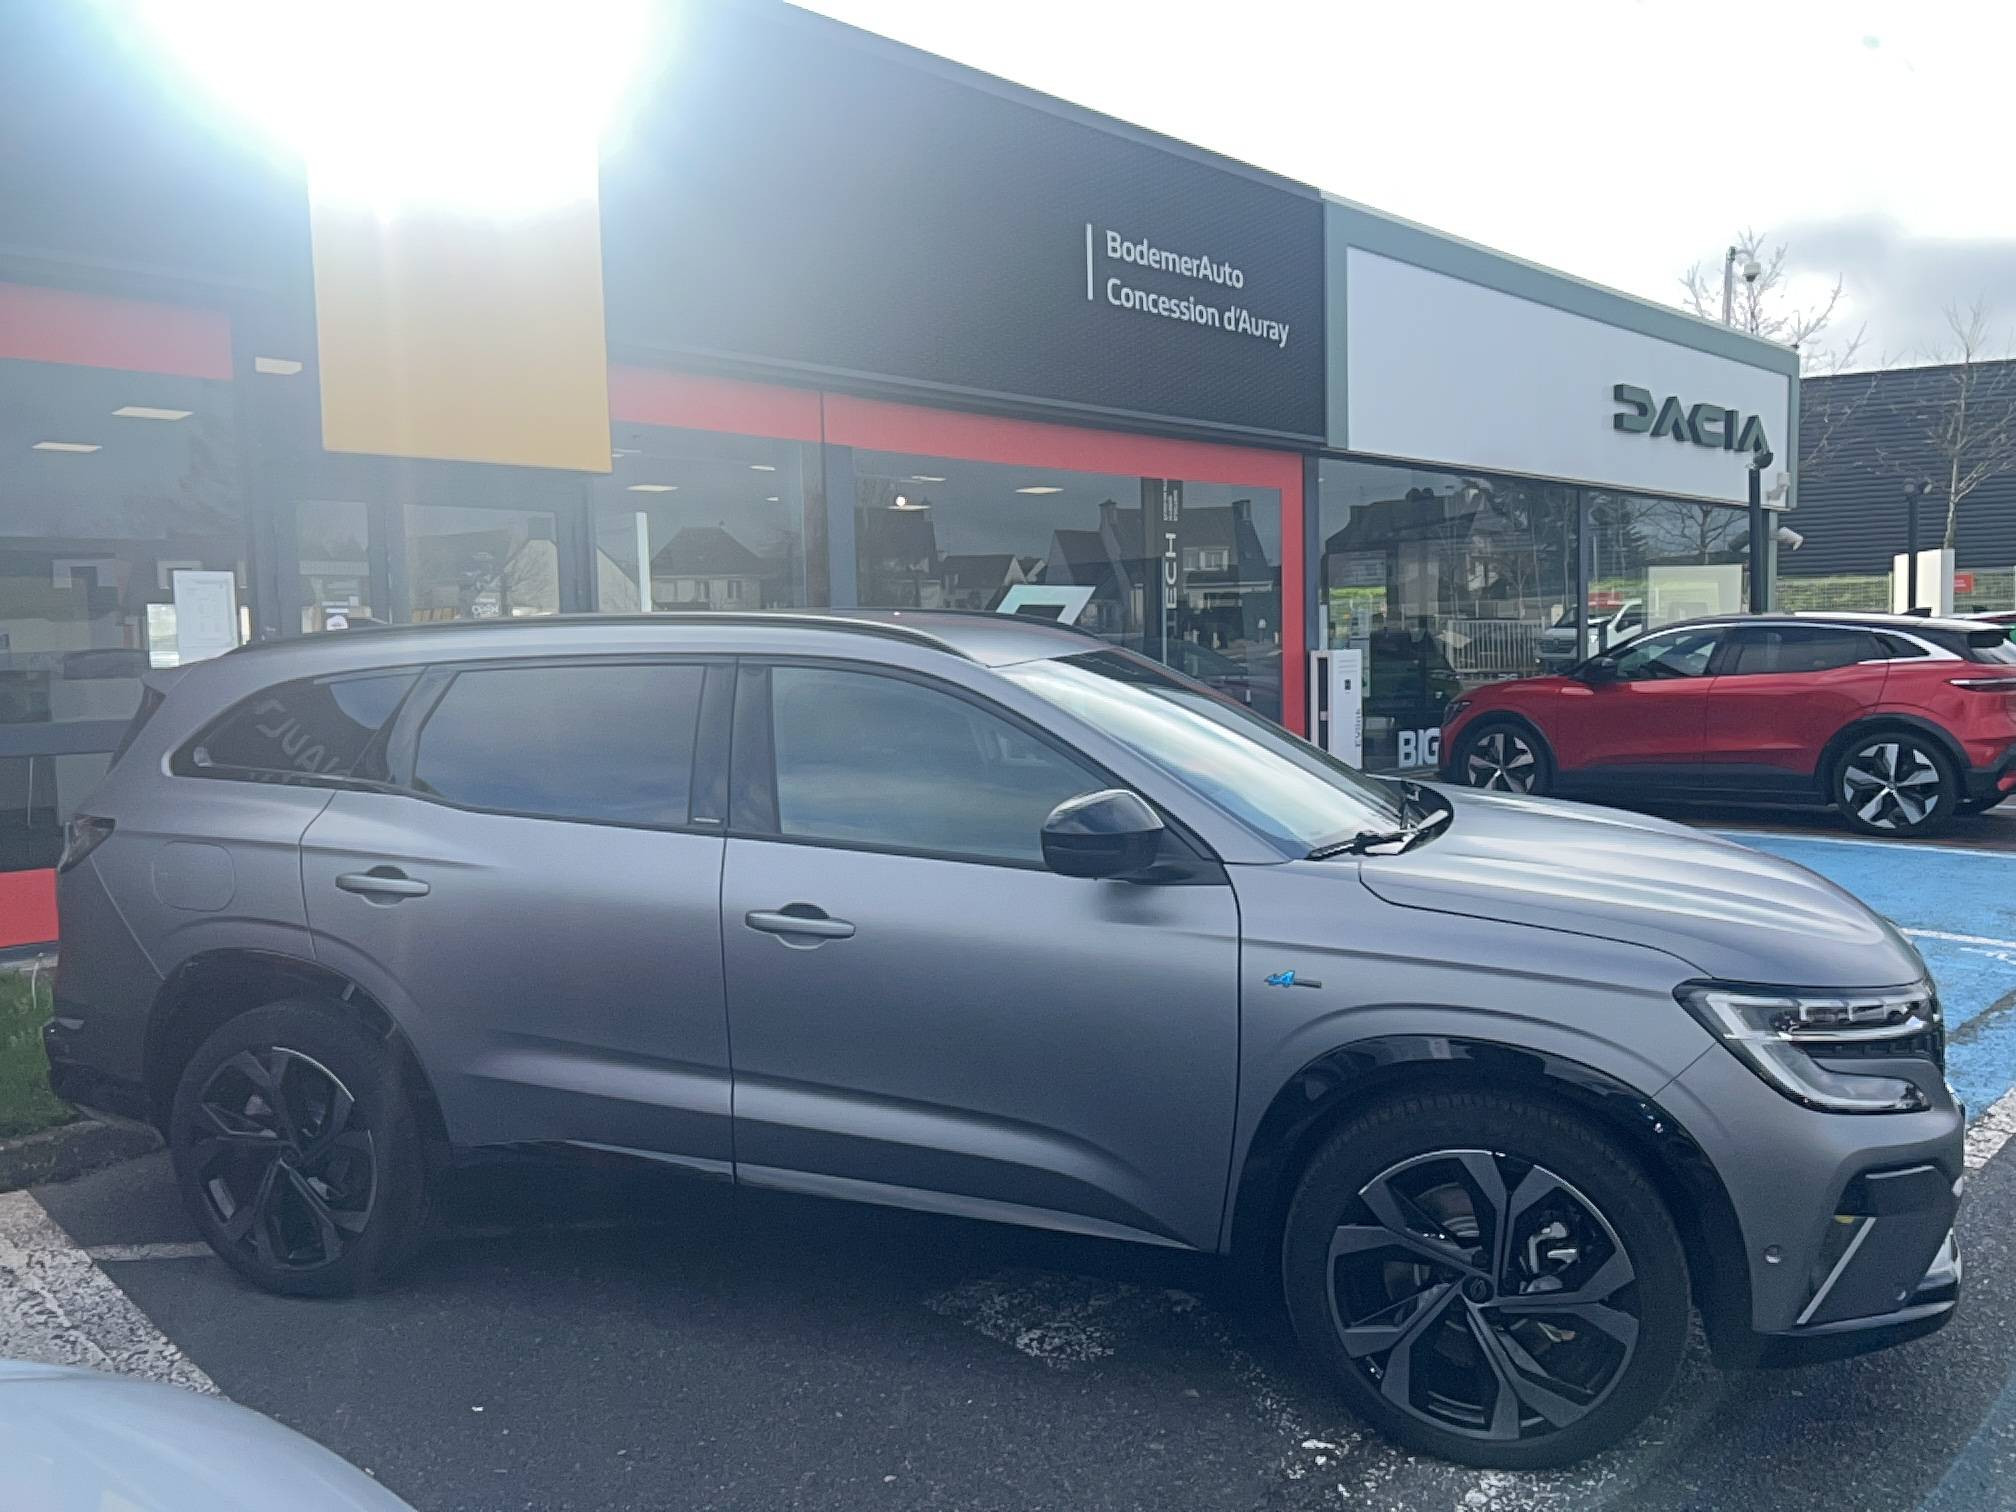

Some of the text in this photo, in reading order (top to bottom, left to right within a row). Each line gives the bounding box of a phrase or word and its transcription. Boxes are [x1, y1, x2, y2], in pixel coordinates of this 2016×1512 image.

[1106, 230, 1244, 289] BodemerAuto
[1107, 278, 1290, 348] Concession d'Auray
[1613, 383, 1771, 455] DACIA
